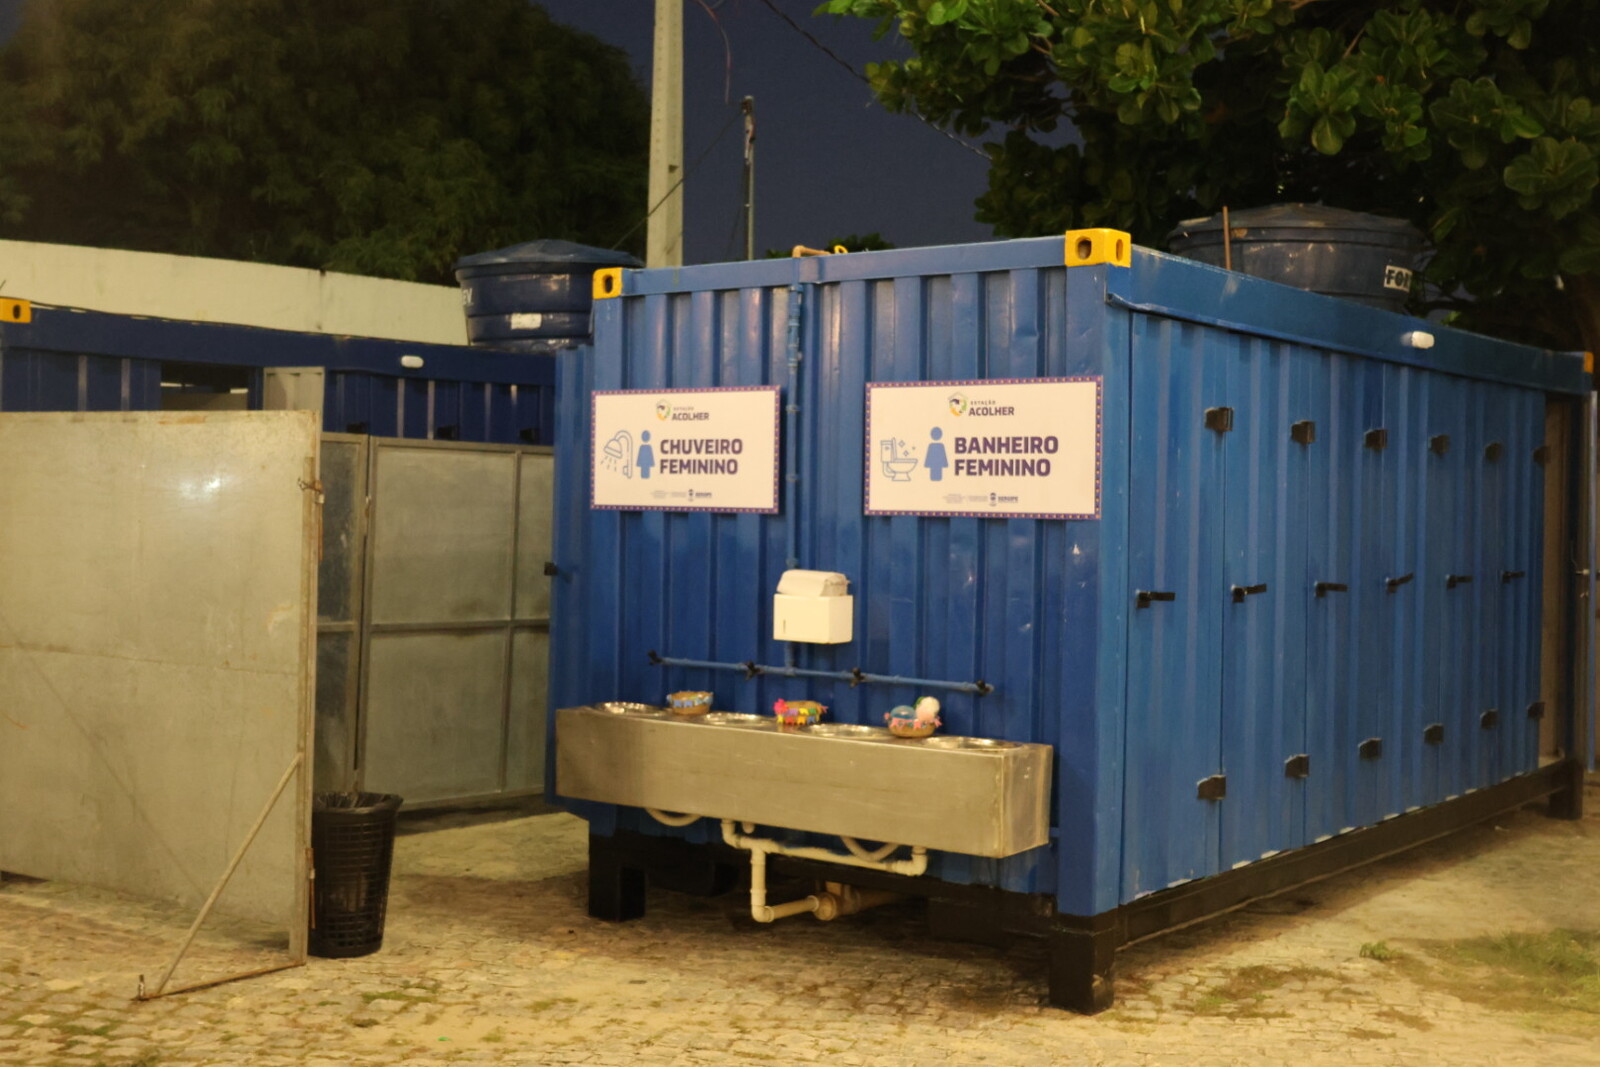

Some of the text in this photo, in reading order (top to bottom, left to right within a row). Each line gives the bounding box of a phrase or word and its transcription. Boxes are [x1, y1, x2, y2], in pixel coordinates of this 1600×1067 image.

[672, 412, 710, 421] ACOLHER
[968, 406, 1015, 416] ACOLHER
[660, 439, 743, 454] CHUVEIRO
[954, 436, 1058, 454] BANHEIRO
[660, 459, 738, 474] FEMININO
[954, 459, 1051, 476] FEMININO
